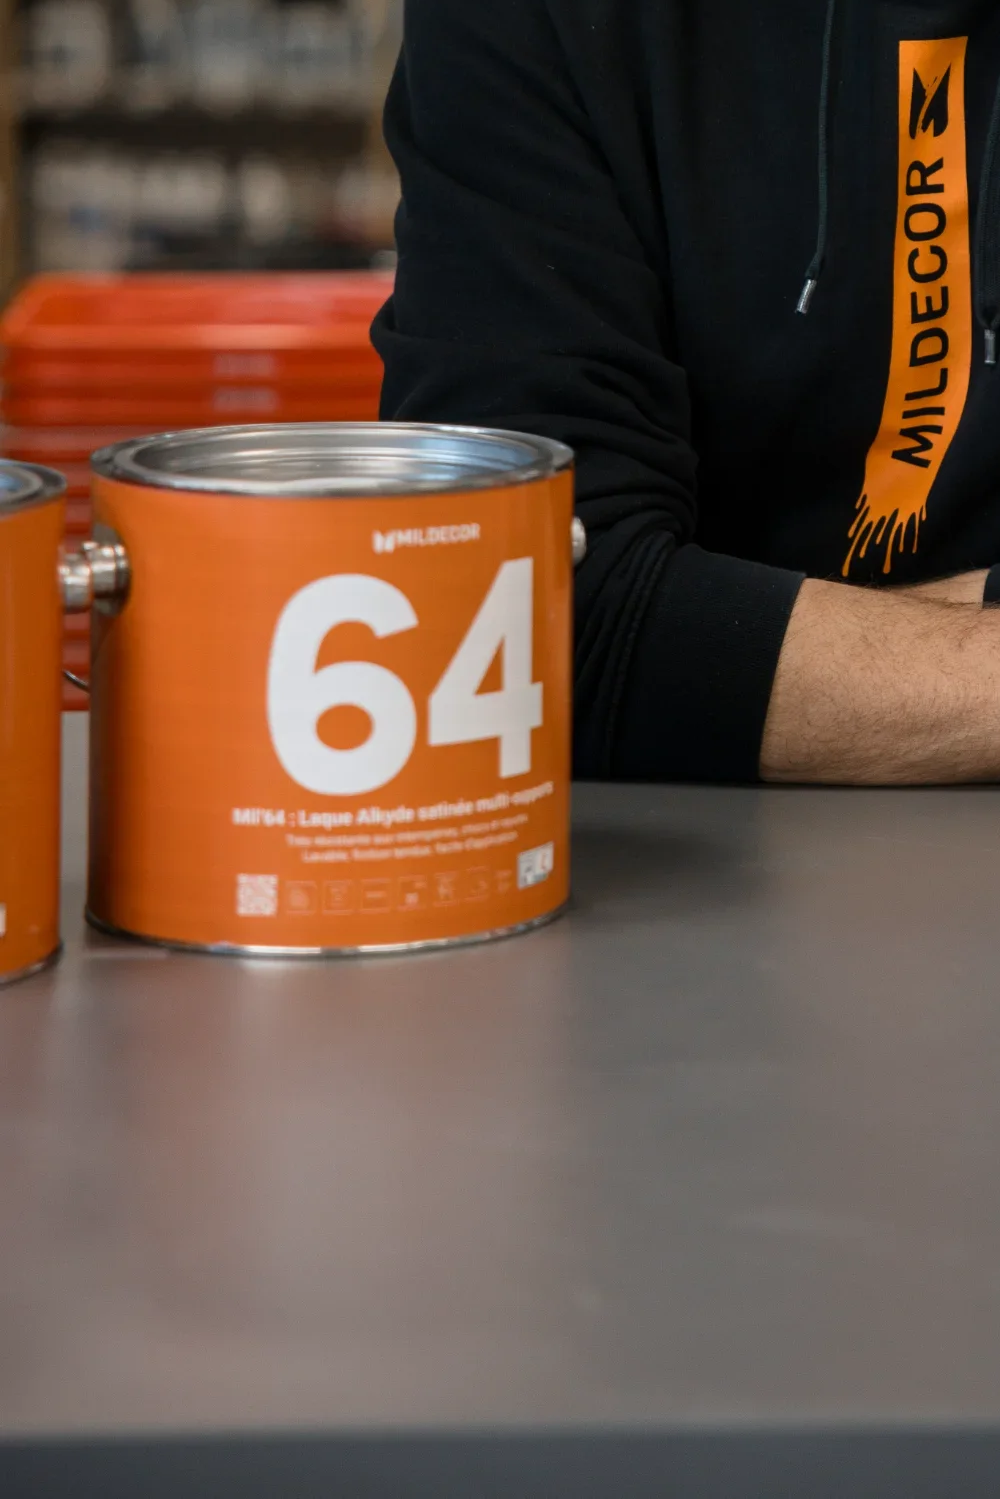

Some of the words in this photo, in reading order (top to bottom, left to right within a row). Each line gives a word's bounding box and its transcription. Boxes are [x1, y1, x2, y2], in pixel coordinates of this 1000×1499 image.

[891, 157, 949, 468] MILDECOR
[396, 522, 481, 548] MILDECOR
[267, 556, 543, 796] 64
[297, 809, 352, 831] Laque
[357, 804, 414, 829] Alkyde
